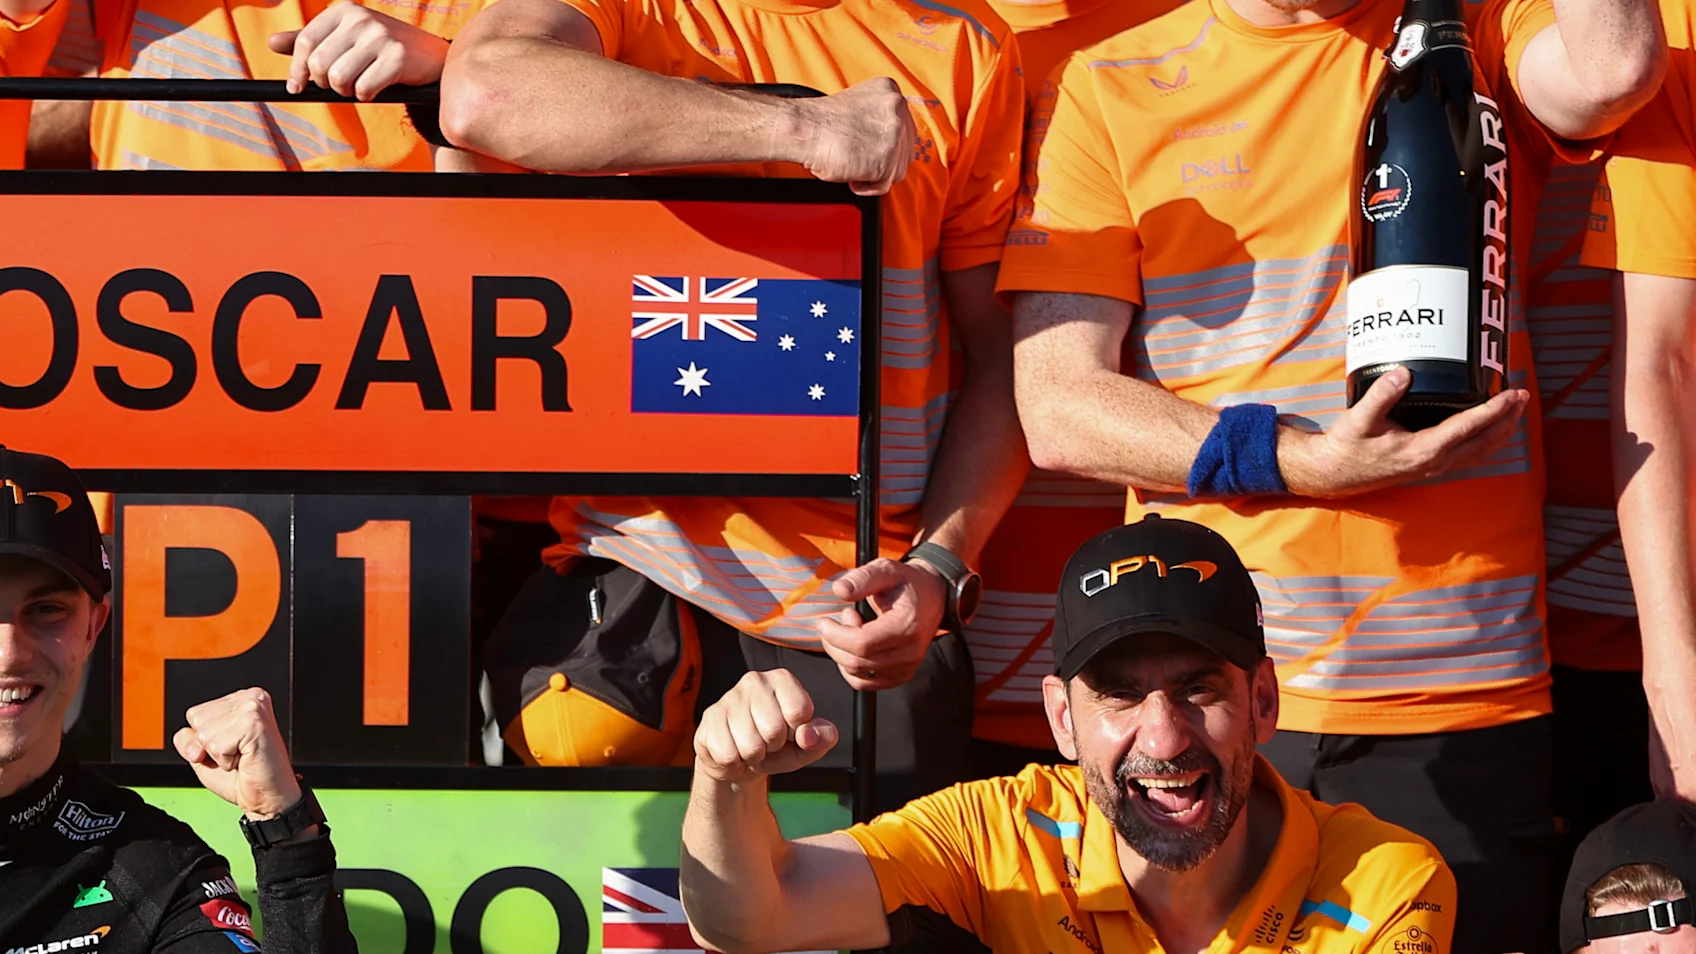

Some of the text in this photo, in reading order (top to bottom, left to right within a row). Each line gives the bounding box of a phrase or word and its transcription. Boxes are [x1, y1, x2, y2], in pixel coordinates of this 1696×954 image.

[1473, 91, 1507, 376] FERRARI
[65, 804, 116, 830] Hilton
[1266, 912, 1285, 944] CISCO
[1394, 940, 1433, 953] Estrella
